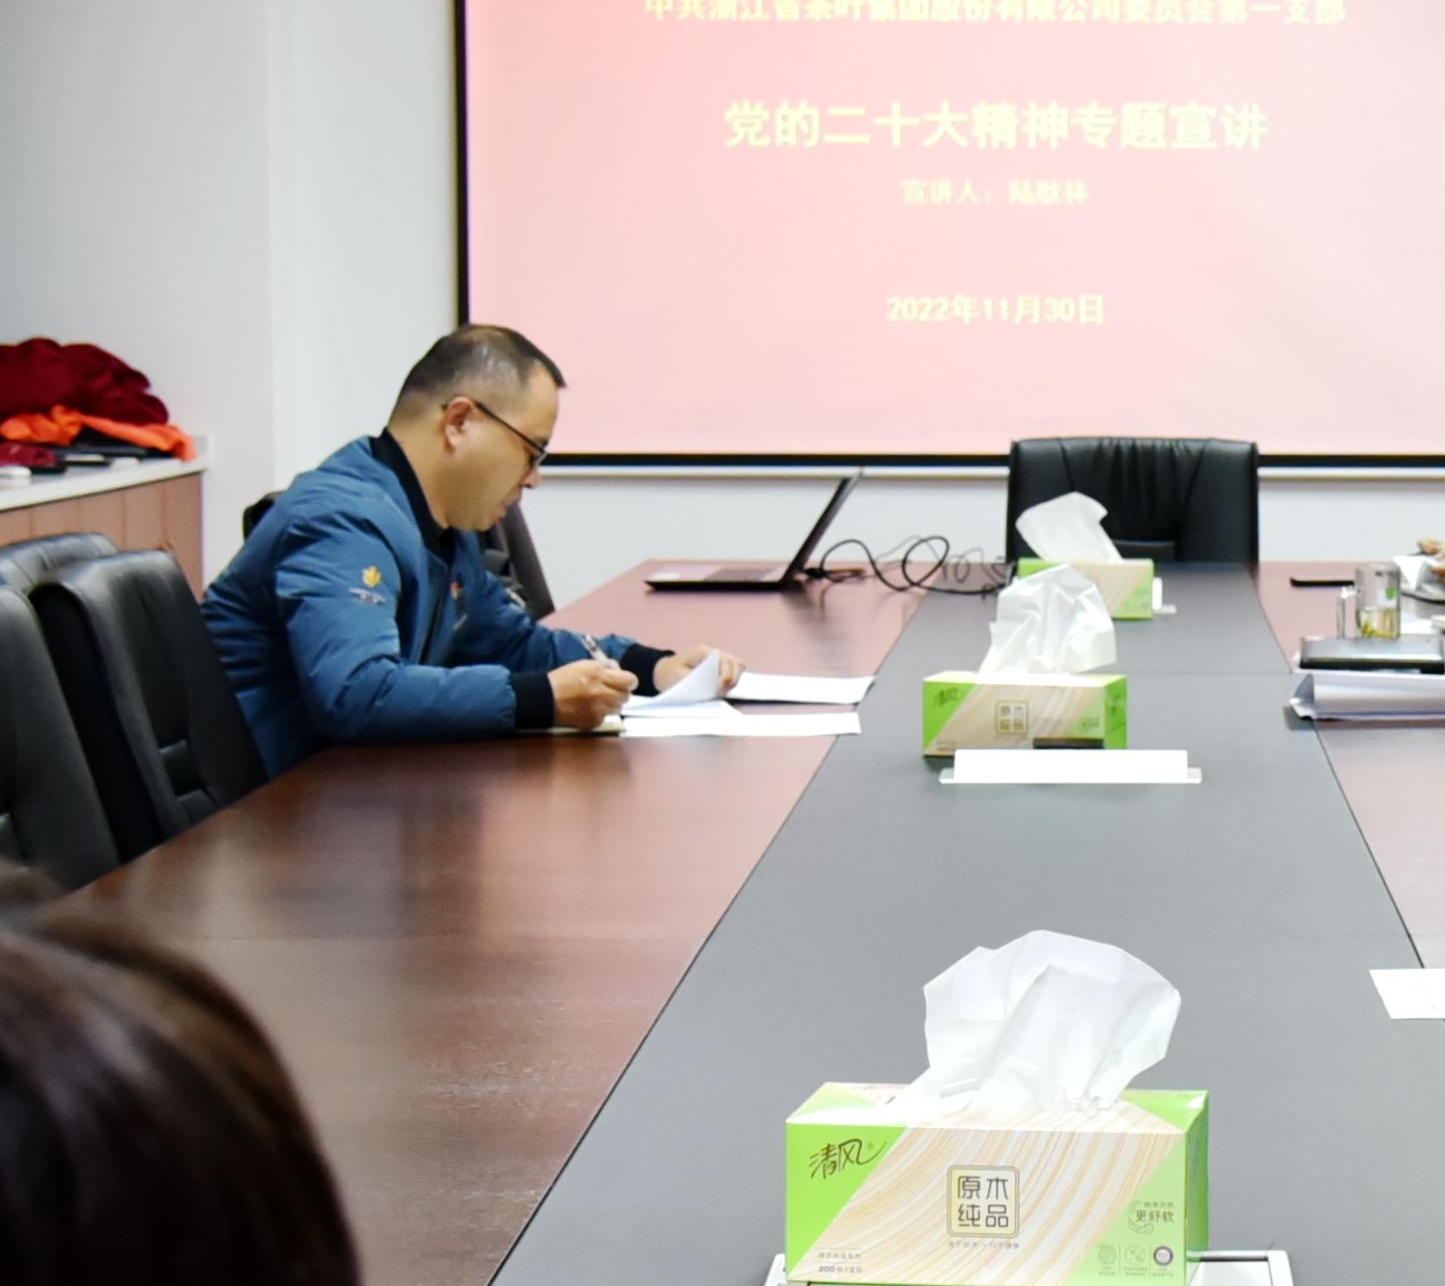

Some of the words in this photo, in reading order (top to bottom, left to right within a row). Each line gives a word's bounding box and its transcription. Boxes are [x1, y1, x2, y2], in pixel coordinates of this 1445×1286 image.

[723, 100, 1268, 149] 党的二十大精神专题宣讲
[886, 293, 1105, 325] 2022年11月30日
[809, 1138, 887, 1179] 清风
[957, 1176, 1009, 1200] 原木
[957, 1204, 1009, 1228] 纯品
